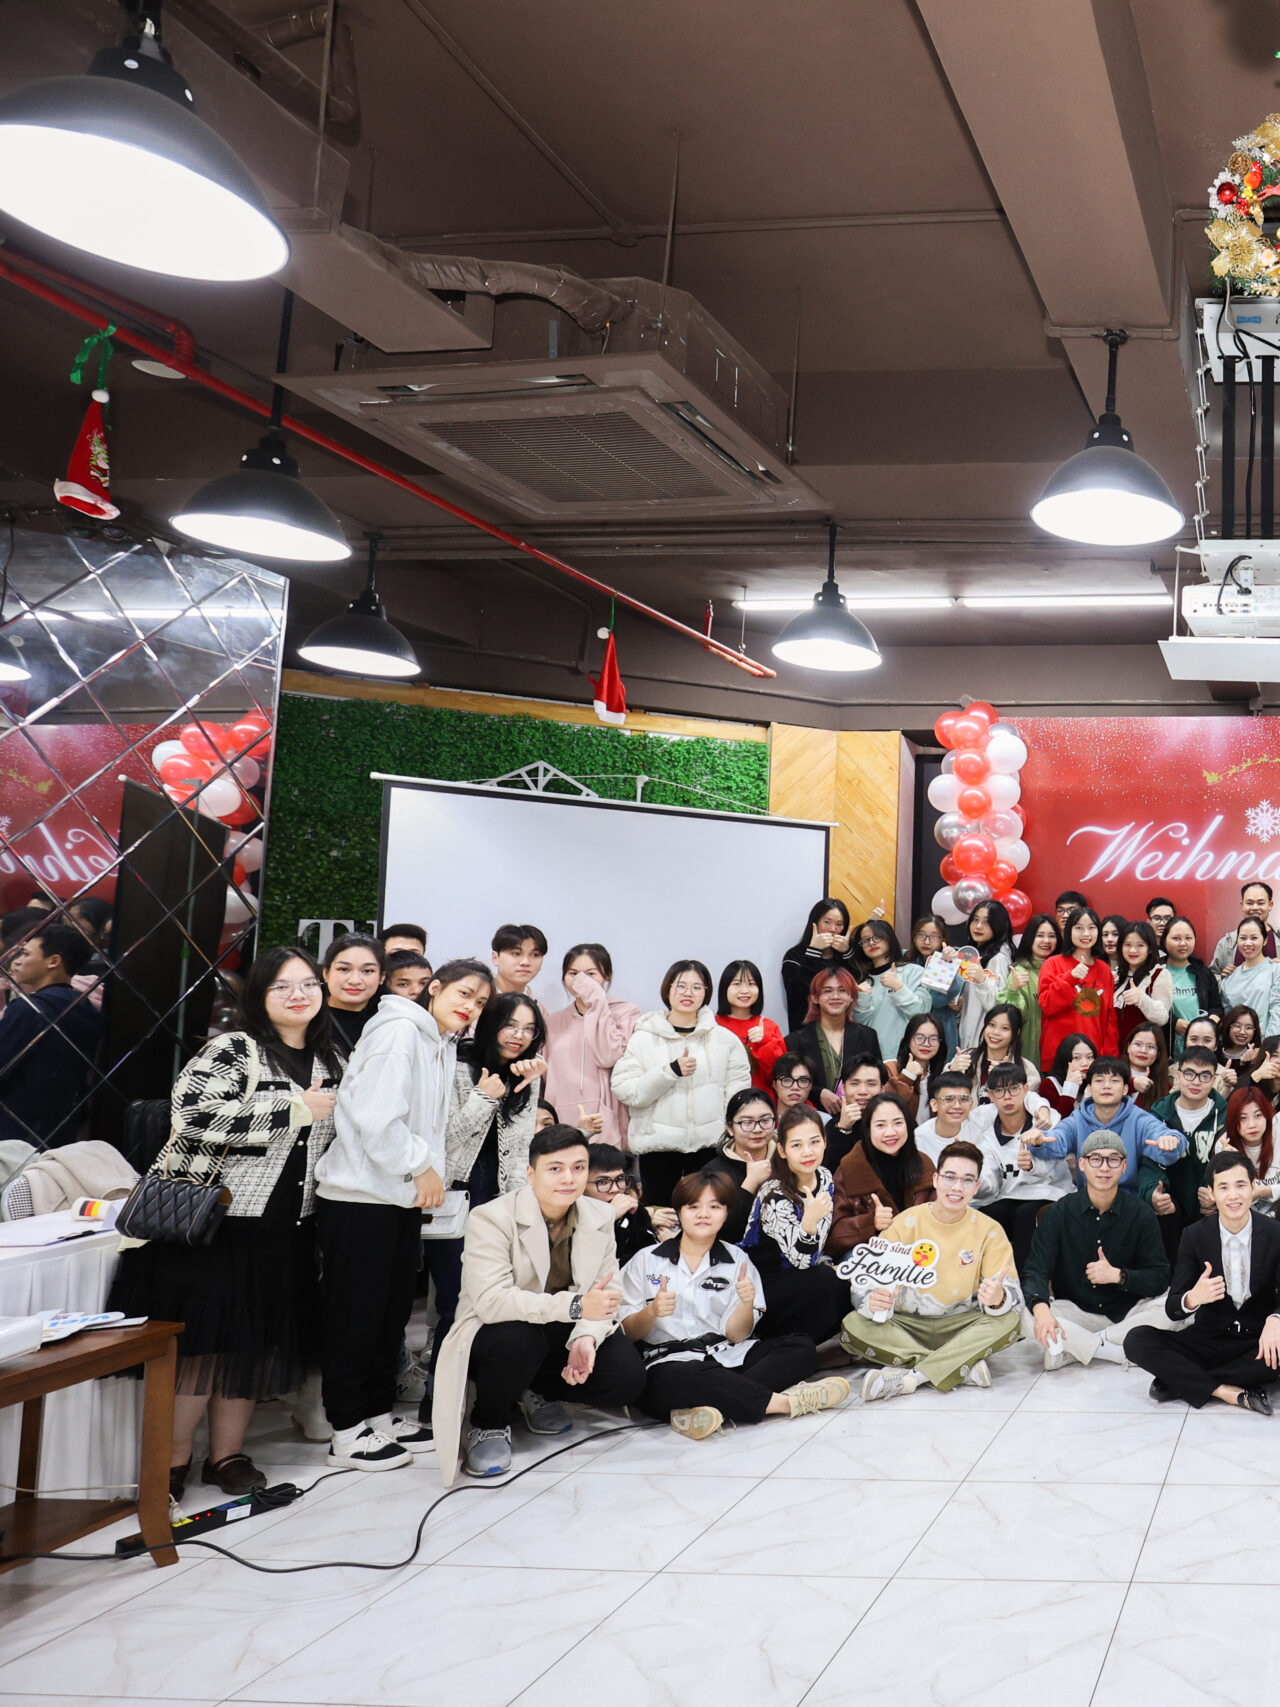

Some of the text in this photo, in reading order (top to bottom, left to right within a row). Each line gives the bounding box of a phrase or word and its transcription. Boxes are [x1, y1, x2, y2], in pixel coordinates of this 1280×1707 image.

[869, 1238, 912, 1256] Wir sind
[840, 1246, 934, 1286] Familie
